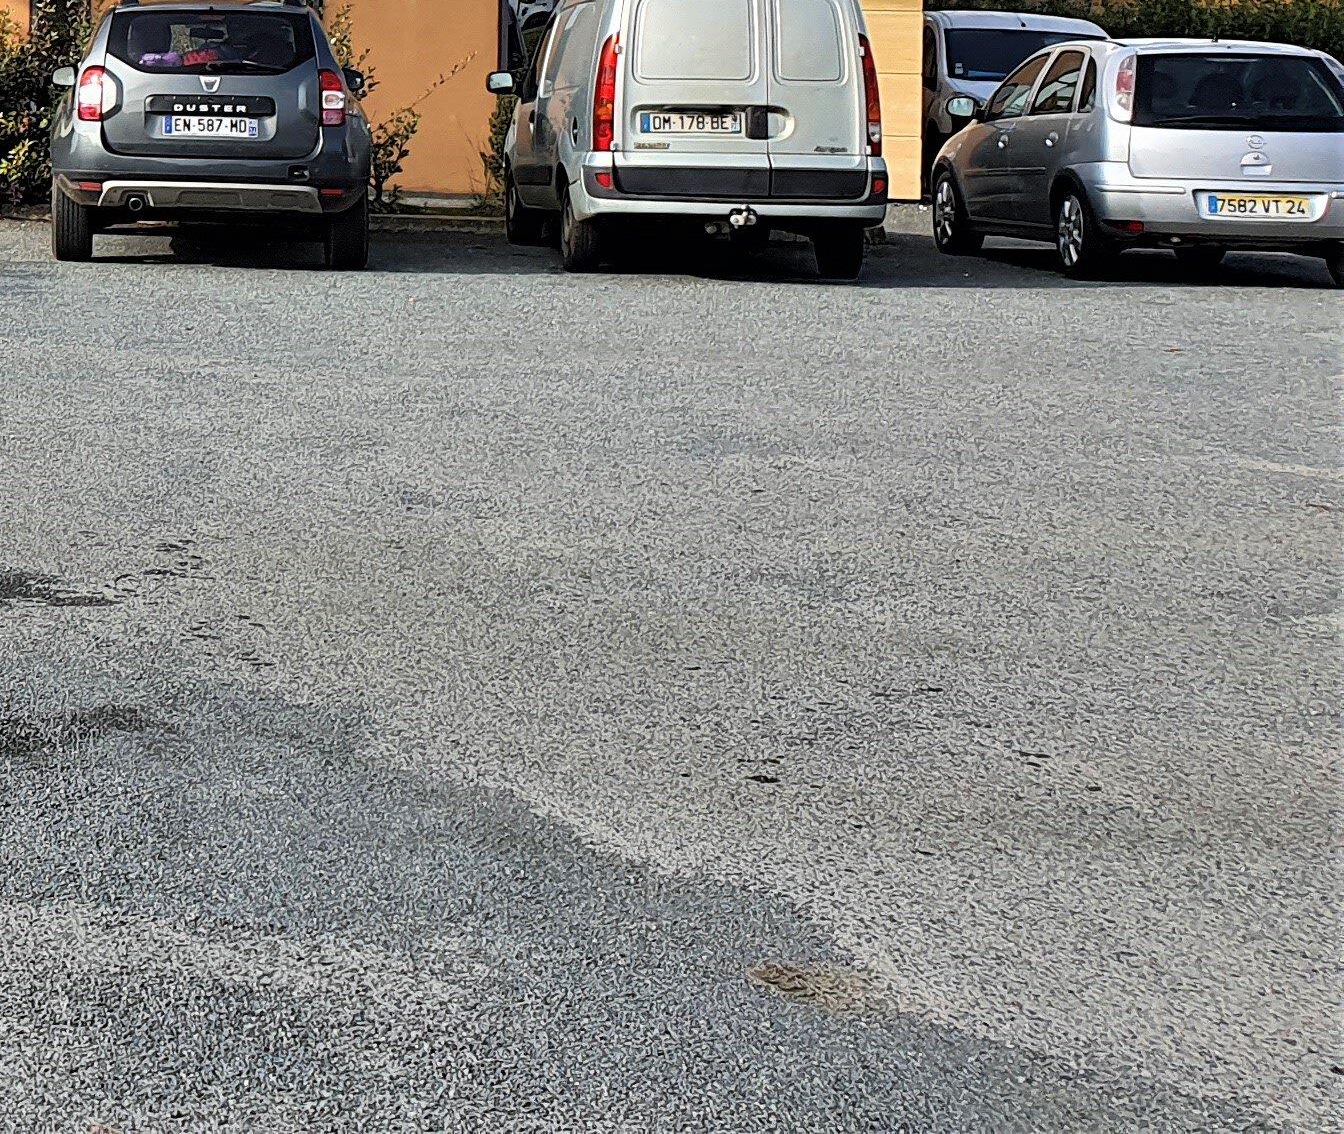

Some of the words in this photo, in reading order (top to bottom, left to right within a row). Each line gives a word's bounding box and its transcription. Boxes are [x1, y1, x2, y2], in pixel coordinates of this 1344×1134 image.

[173, 104, 247, 113] DUSTER
[1217, 198, 1257, 213] 7582
[1261, 200, 1282, 214] VT
[1286, 200, 1306, 214] 24
